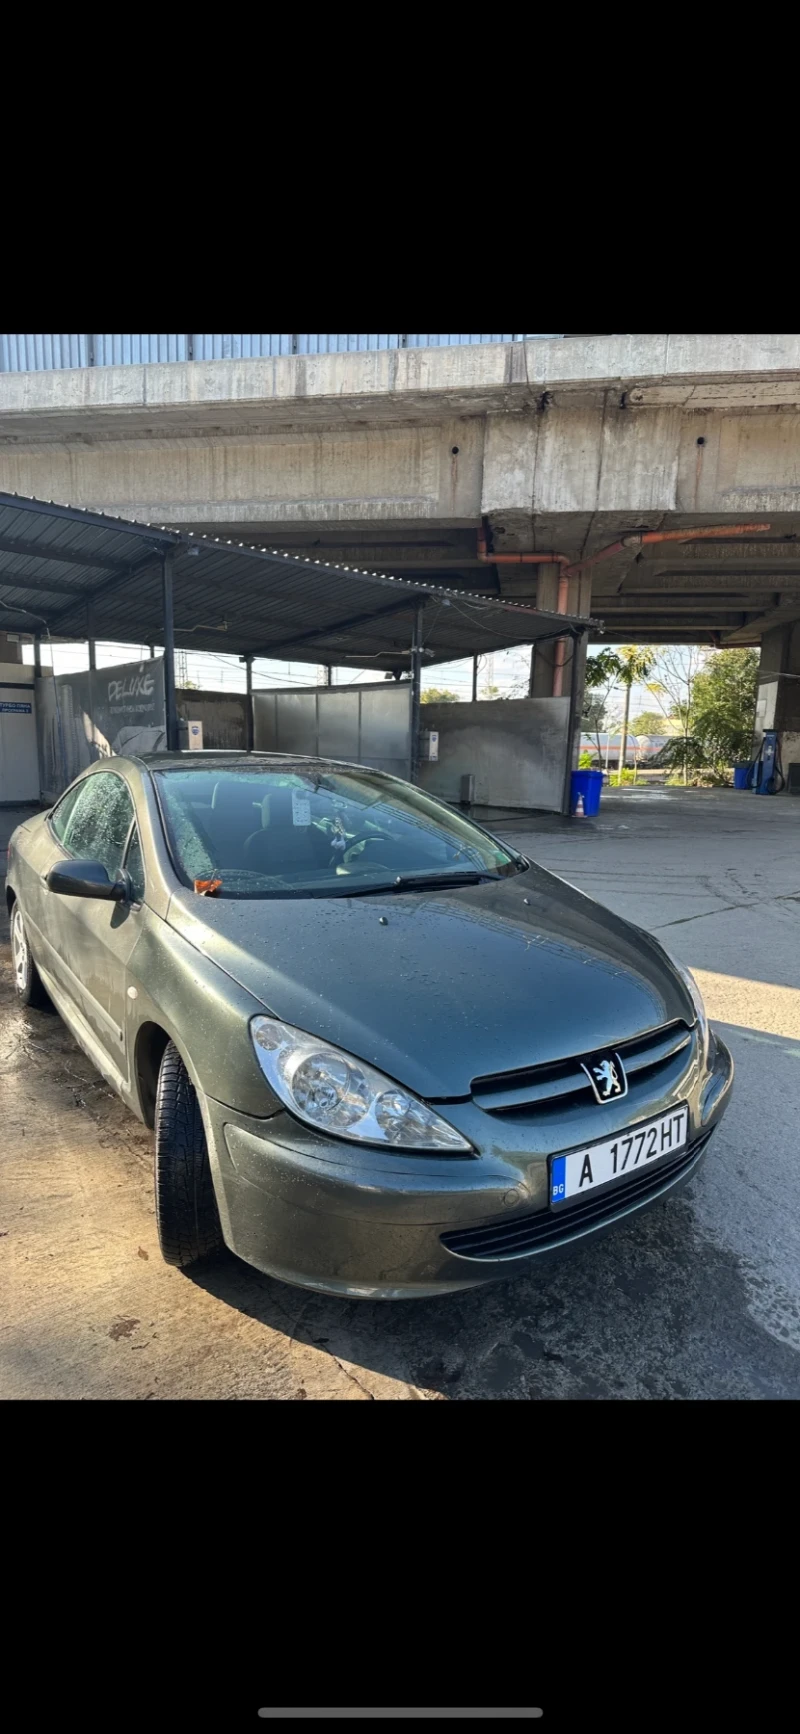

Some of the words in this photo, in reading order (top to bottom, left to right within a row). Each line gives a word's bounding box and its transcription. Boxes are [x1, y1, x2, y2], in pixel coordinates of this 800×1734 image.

[108, 674, 154, 702] DELUXE
[578, 1153, 593, 1188] A
[552, 1183, 564, 1196] BG
